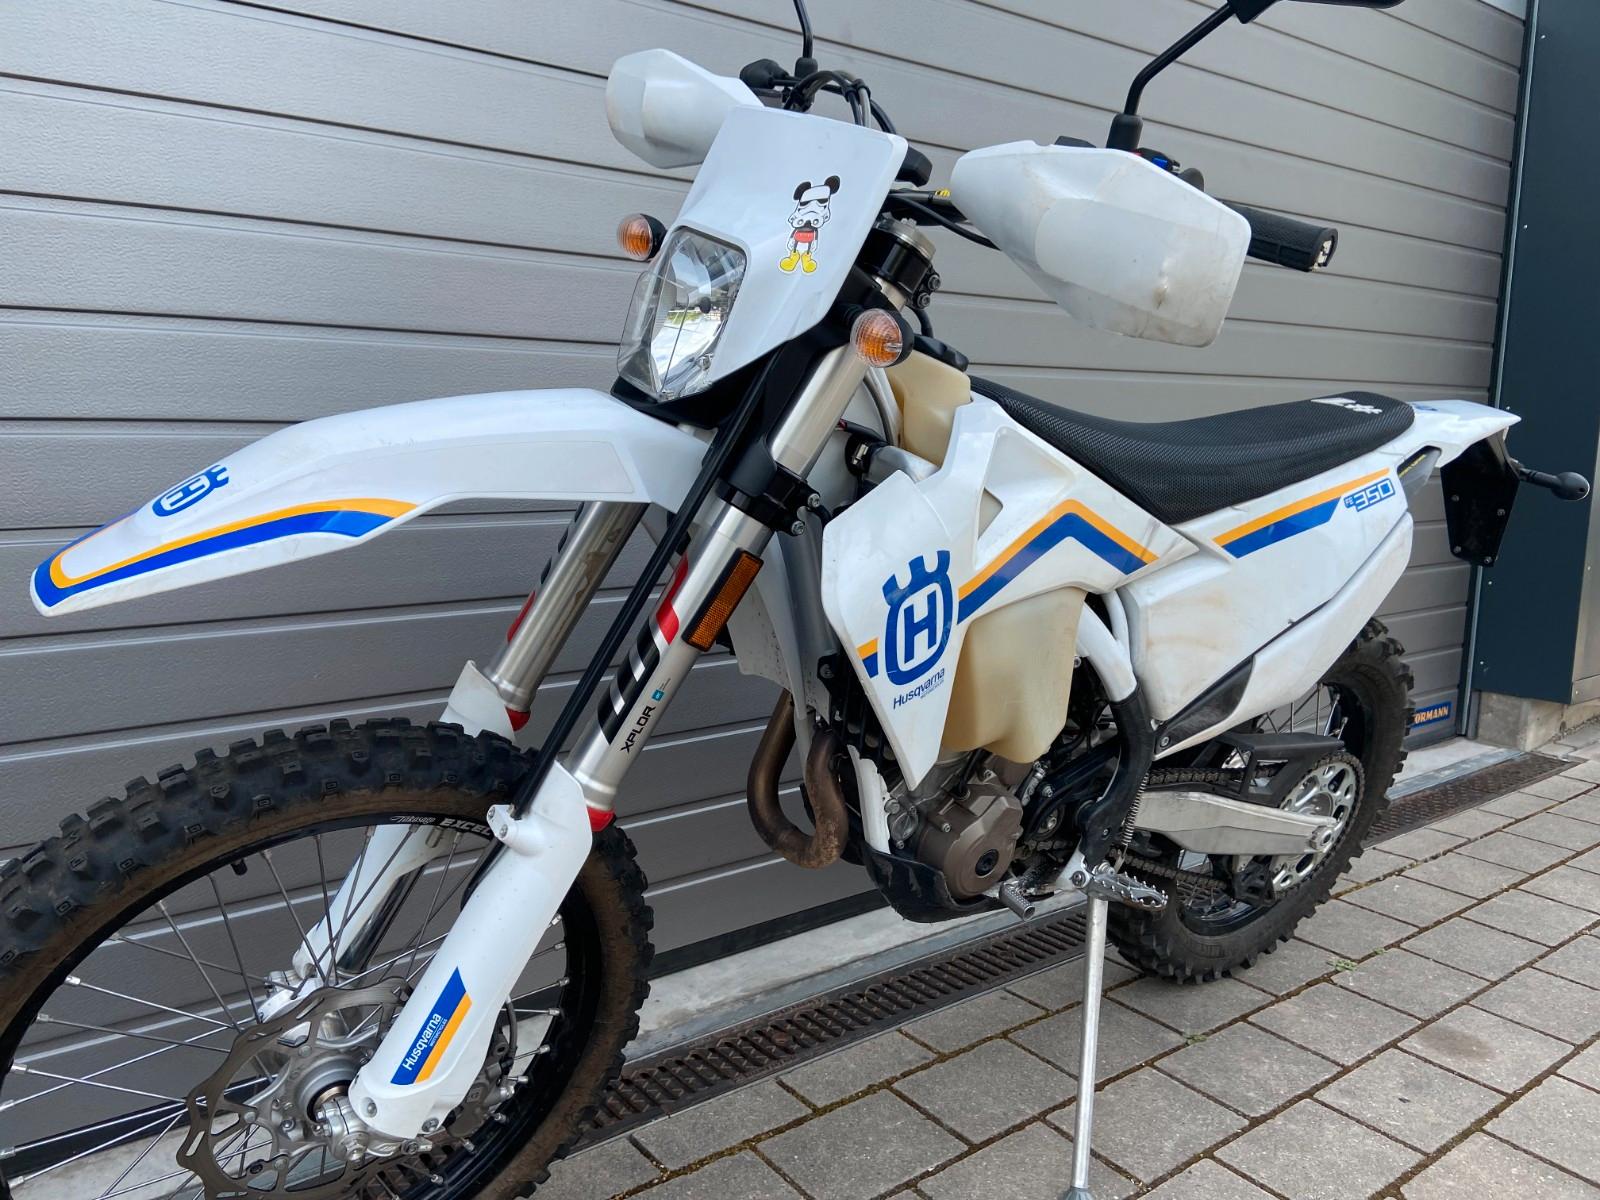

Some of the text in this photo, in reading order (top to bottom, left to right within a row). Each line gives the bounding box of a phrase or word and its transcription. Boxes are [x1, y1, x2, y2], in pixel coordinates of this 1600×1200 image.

[1354, 480, 1394, 509] 350
[893, 668, 945, 710] Husqvarna
[620, 705, 656, 753] XPLOR
[440, 818, 492, 836] EXCEL
[402, 1013, 442, 1071] Husqvarna
